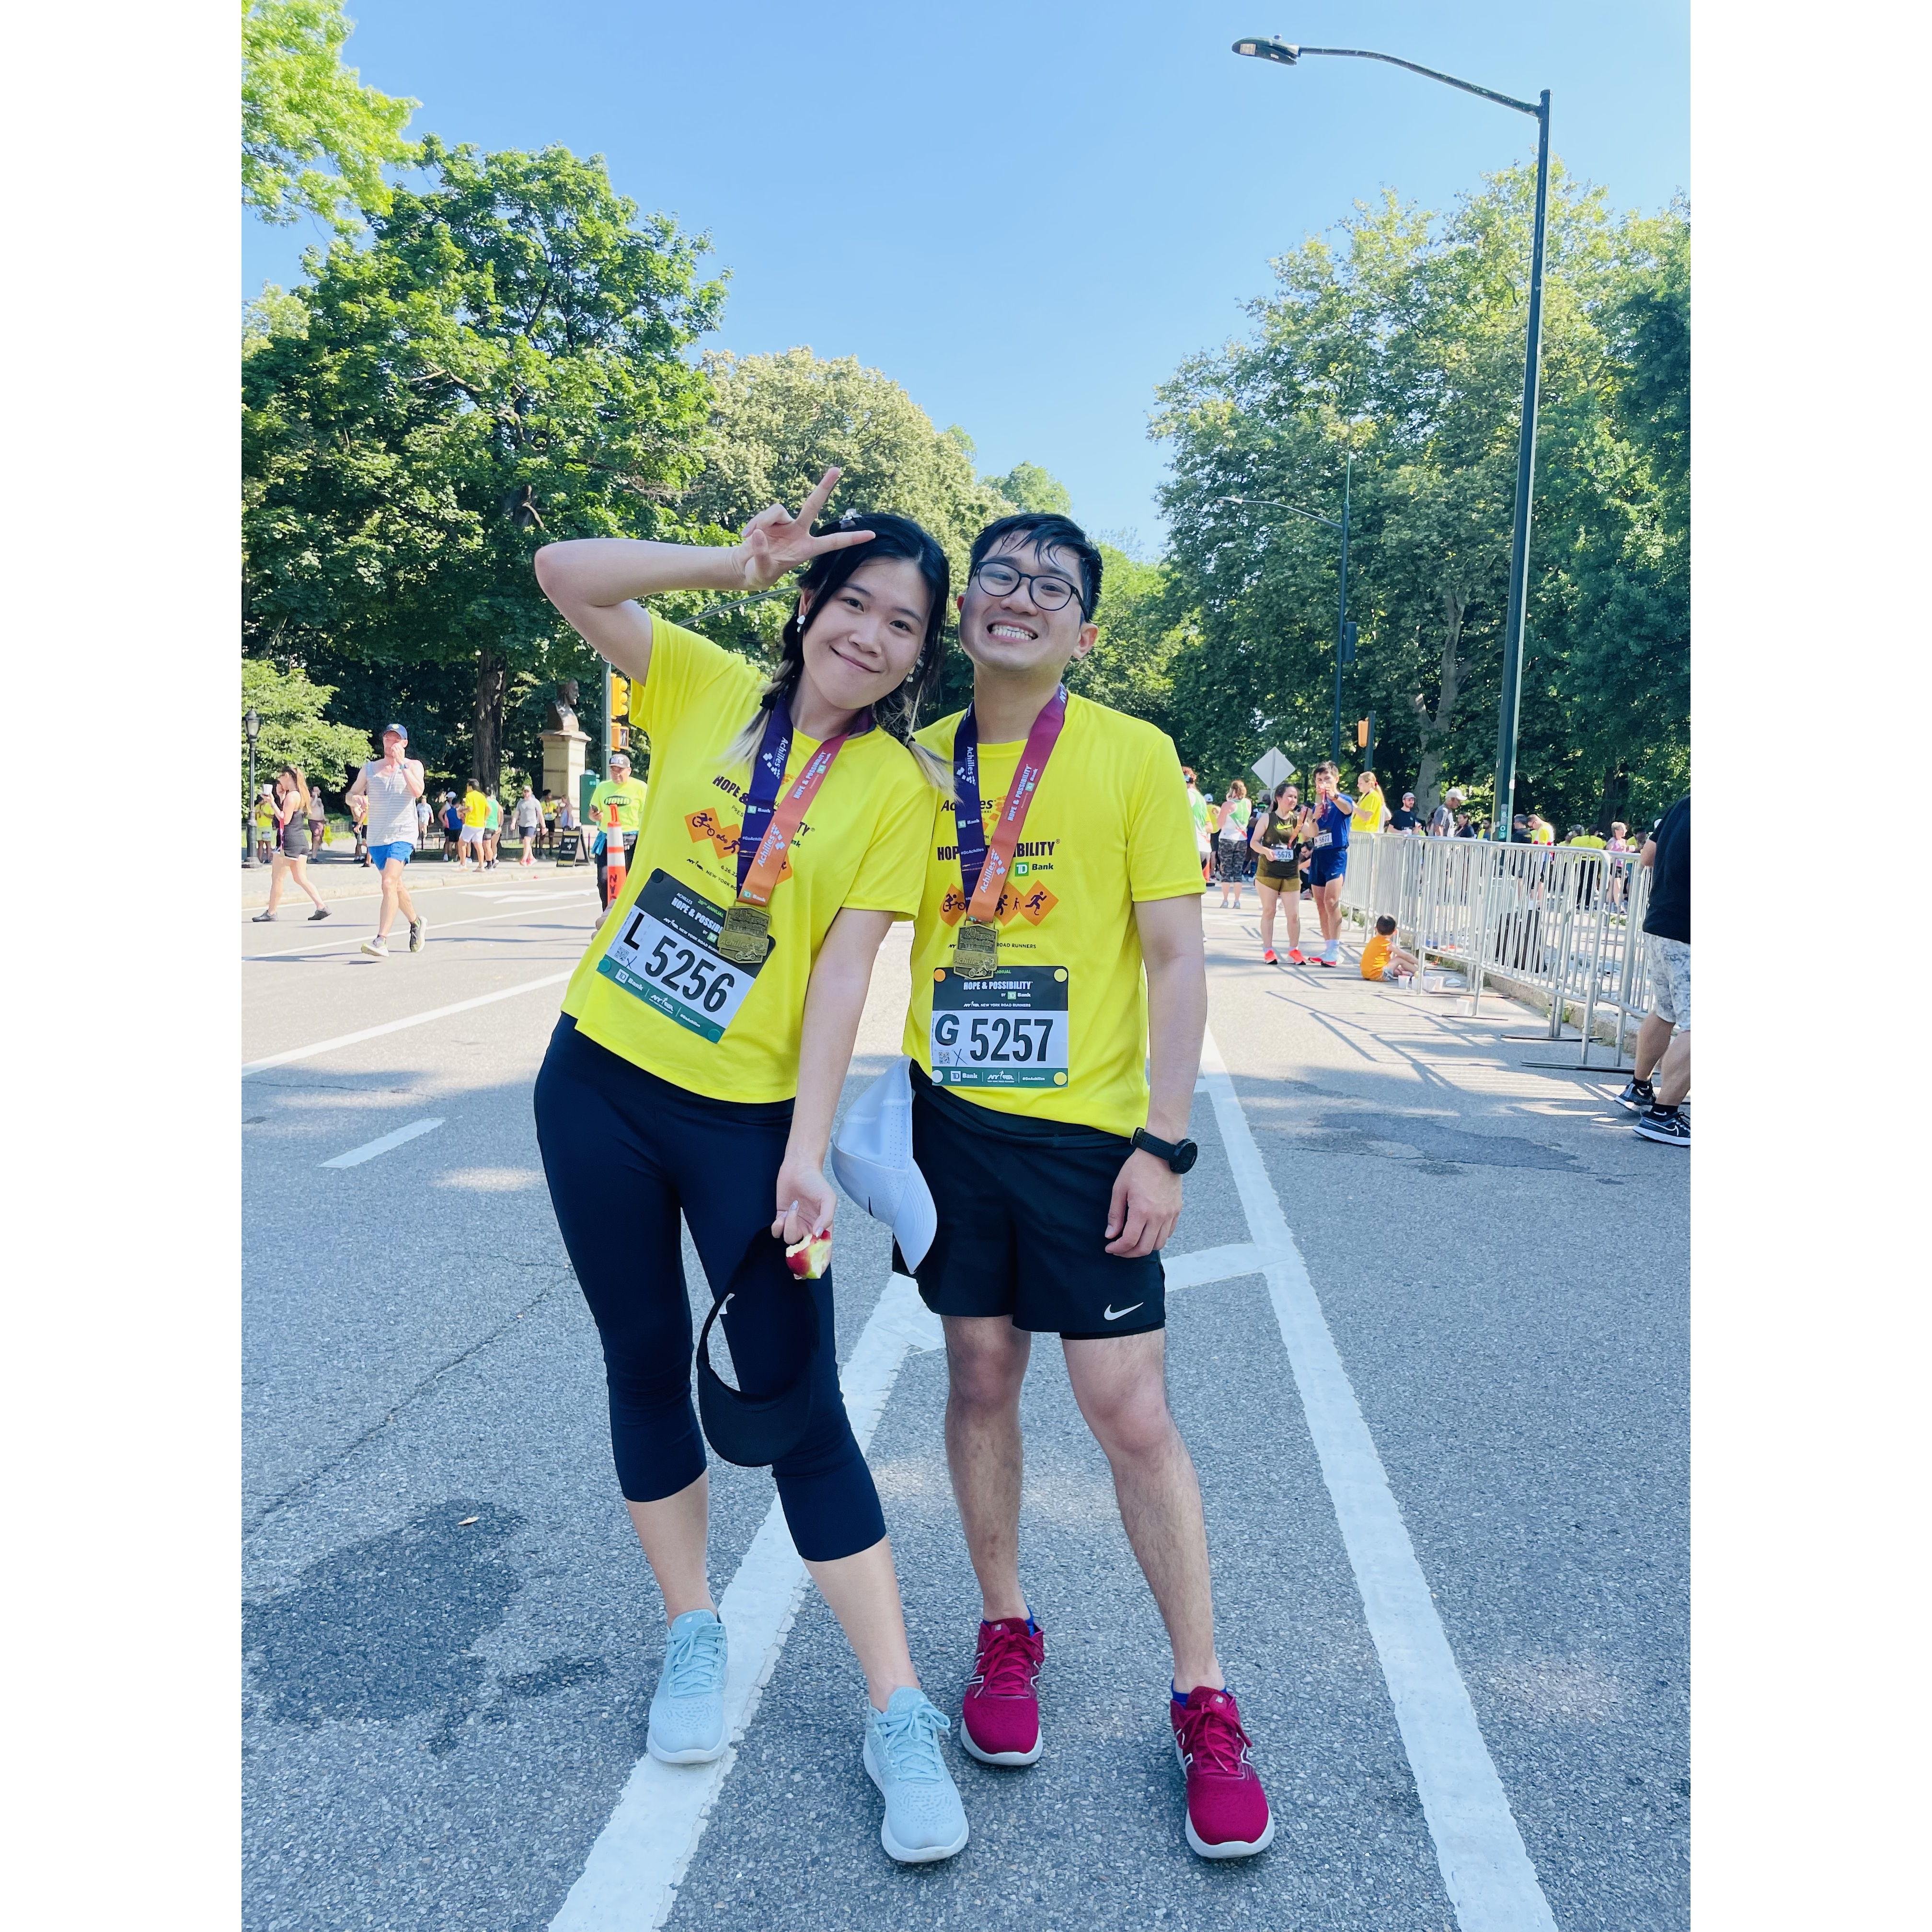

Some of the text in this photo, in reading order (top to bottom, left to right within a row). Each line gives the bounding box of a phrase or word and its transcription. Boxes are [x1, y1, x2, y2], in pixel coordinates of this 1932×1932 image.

[775, 737, 789, 767] Achilles
[793, 785, 806, 799] HOPE
[805, 750, 827, 779] POSSIBILITY
[712, 775, 741, 798] HOPE
[1008, 806, 1017, 821] HOPE
[1015, 766, 1032, 798] POSSIBILITY
[758, 835, 775, 868] Achilles
[937, 846, 960, 861] HOP
[705, 870, 717, 878] NEW
[718, 877, 732, 887] YORK
[980, 861, 996, 893] Achilles
[1016, 863, 1028, 875] TD
[671, 897, 690, 914] HOPE
[688, 908, 696, 918] &
[676, 893, 693, 905] ACHILLES
[706, 905, 724, 918] ANNUAL
[623, 912, 645, 951] L
[965, 927, 977, 938] 20
[697, 939, 708, 947] ROAD
[954, 956, 981, 966] Achilles
[617, 970, 644, 991] TD Bank
[645, 935, 735, 1012] 5256
[963, 981, 1031, 990] HOPE & POSSIBILITY
[935, 1013, 959, 1046] G
[970, 1018, 1053, 1061] 5257
[951, 1072, 960, 1080] TD
